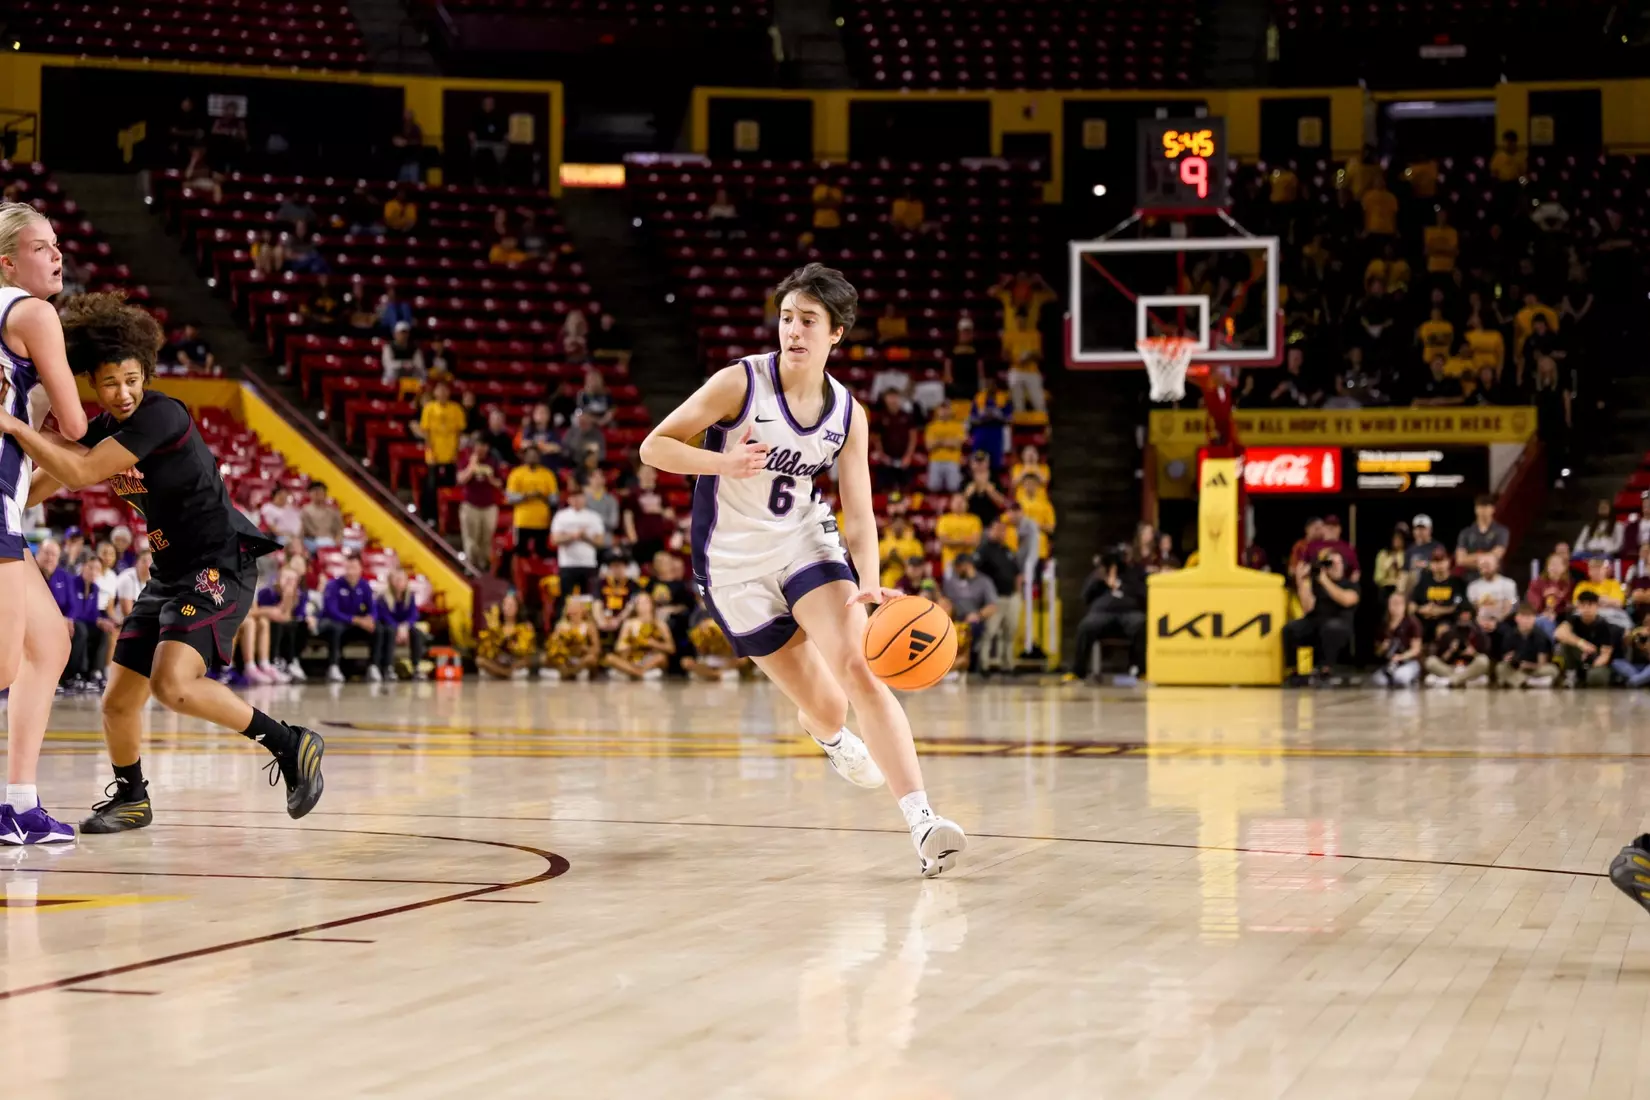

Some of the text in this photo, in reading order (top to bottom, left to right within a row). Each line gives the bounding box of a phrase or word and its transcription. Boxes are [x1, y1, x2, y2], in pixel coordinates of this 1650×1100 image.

[1162, 129, 1214, 158] 5:45
[1180, 156, 1207, 198] 9
[1259, 417, 1283, 433] ALL
[1289, 416, 1327, 433] HOPE
[1360, 416, 1397, 432] WHO
[1402, 415, 1454, 432] ENTER
[1460, 415, 1502, 432] HERE
[767, 474, 796, 518] 6
[1157, 611, 1272, 638] KIA
